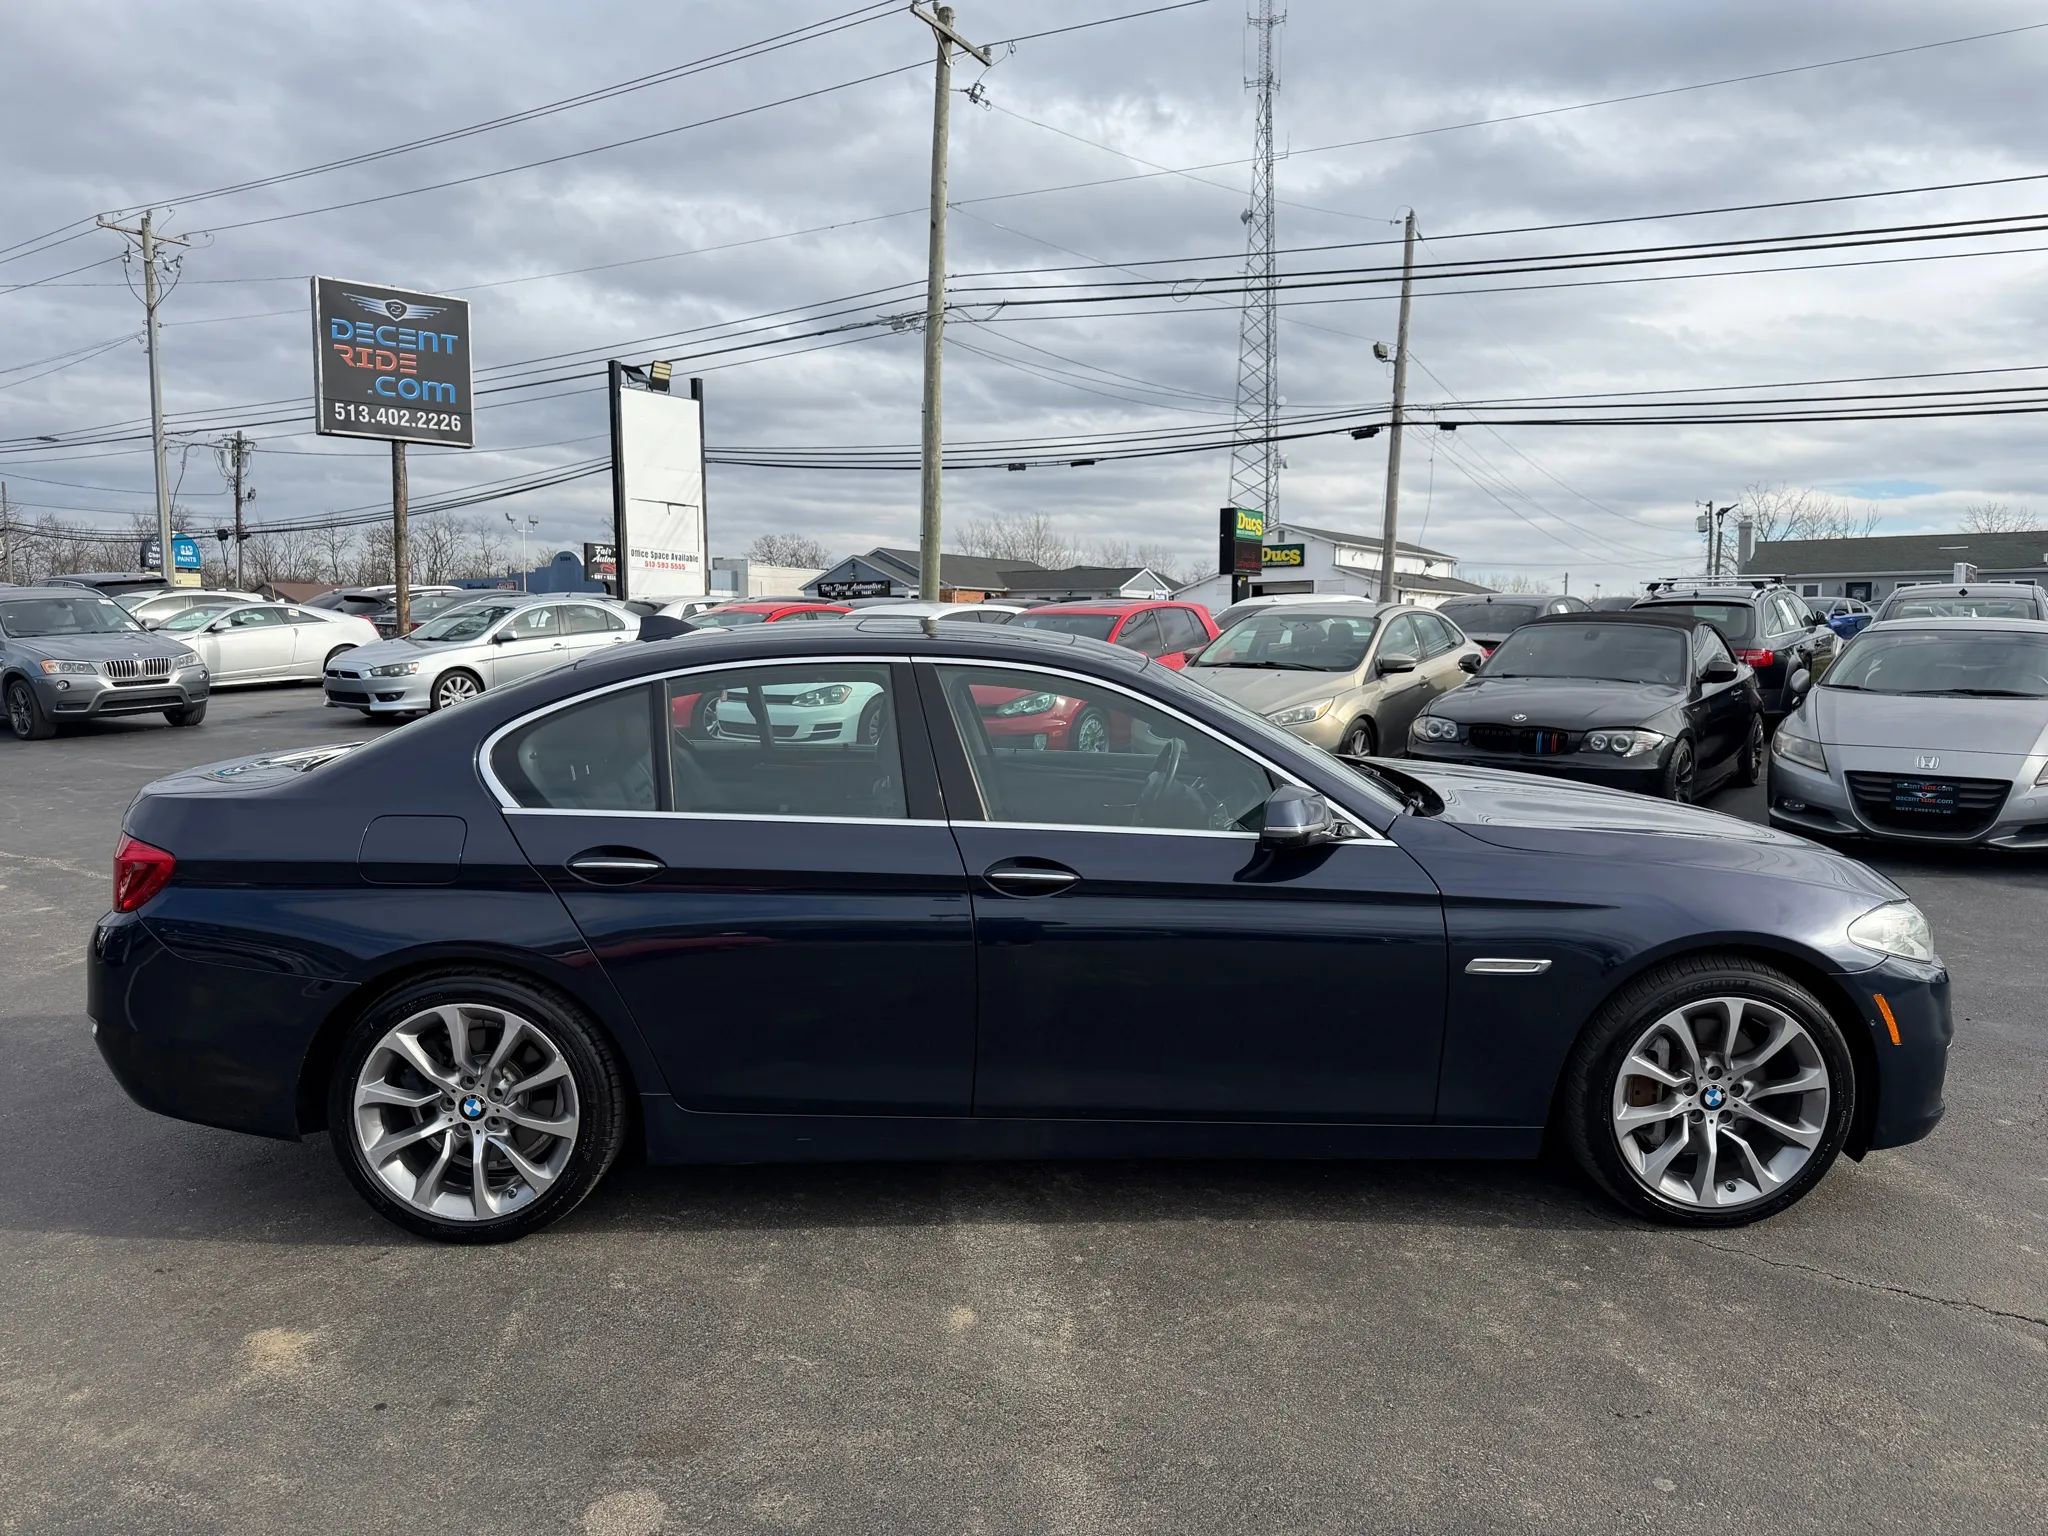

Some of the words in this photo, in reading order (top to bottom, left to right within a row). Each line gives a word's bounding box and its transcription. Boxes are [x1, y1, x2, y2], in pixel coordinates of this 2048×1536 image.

[331, 318, 459, 355] DECENT
[333, 343, 417, 374] RIDE
[334, 402, 462, 432] 513.402.2226
[1237, 511, 1263, 537] Ducs
[177, 555, 197, 563] PAINTS
[594, 545, 612, 556] Fair
[630, 549, 649, 559] Office
[650, 551, 670, 560] Space
[670, 552, 699, 563] Available
[1261, 547, 1301, 565] Ducs
[820, 584, 833, 592] Fair
[833, 583, 849, 591] Deal
[850, 582, 882, 591] Automotive
